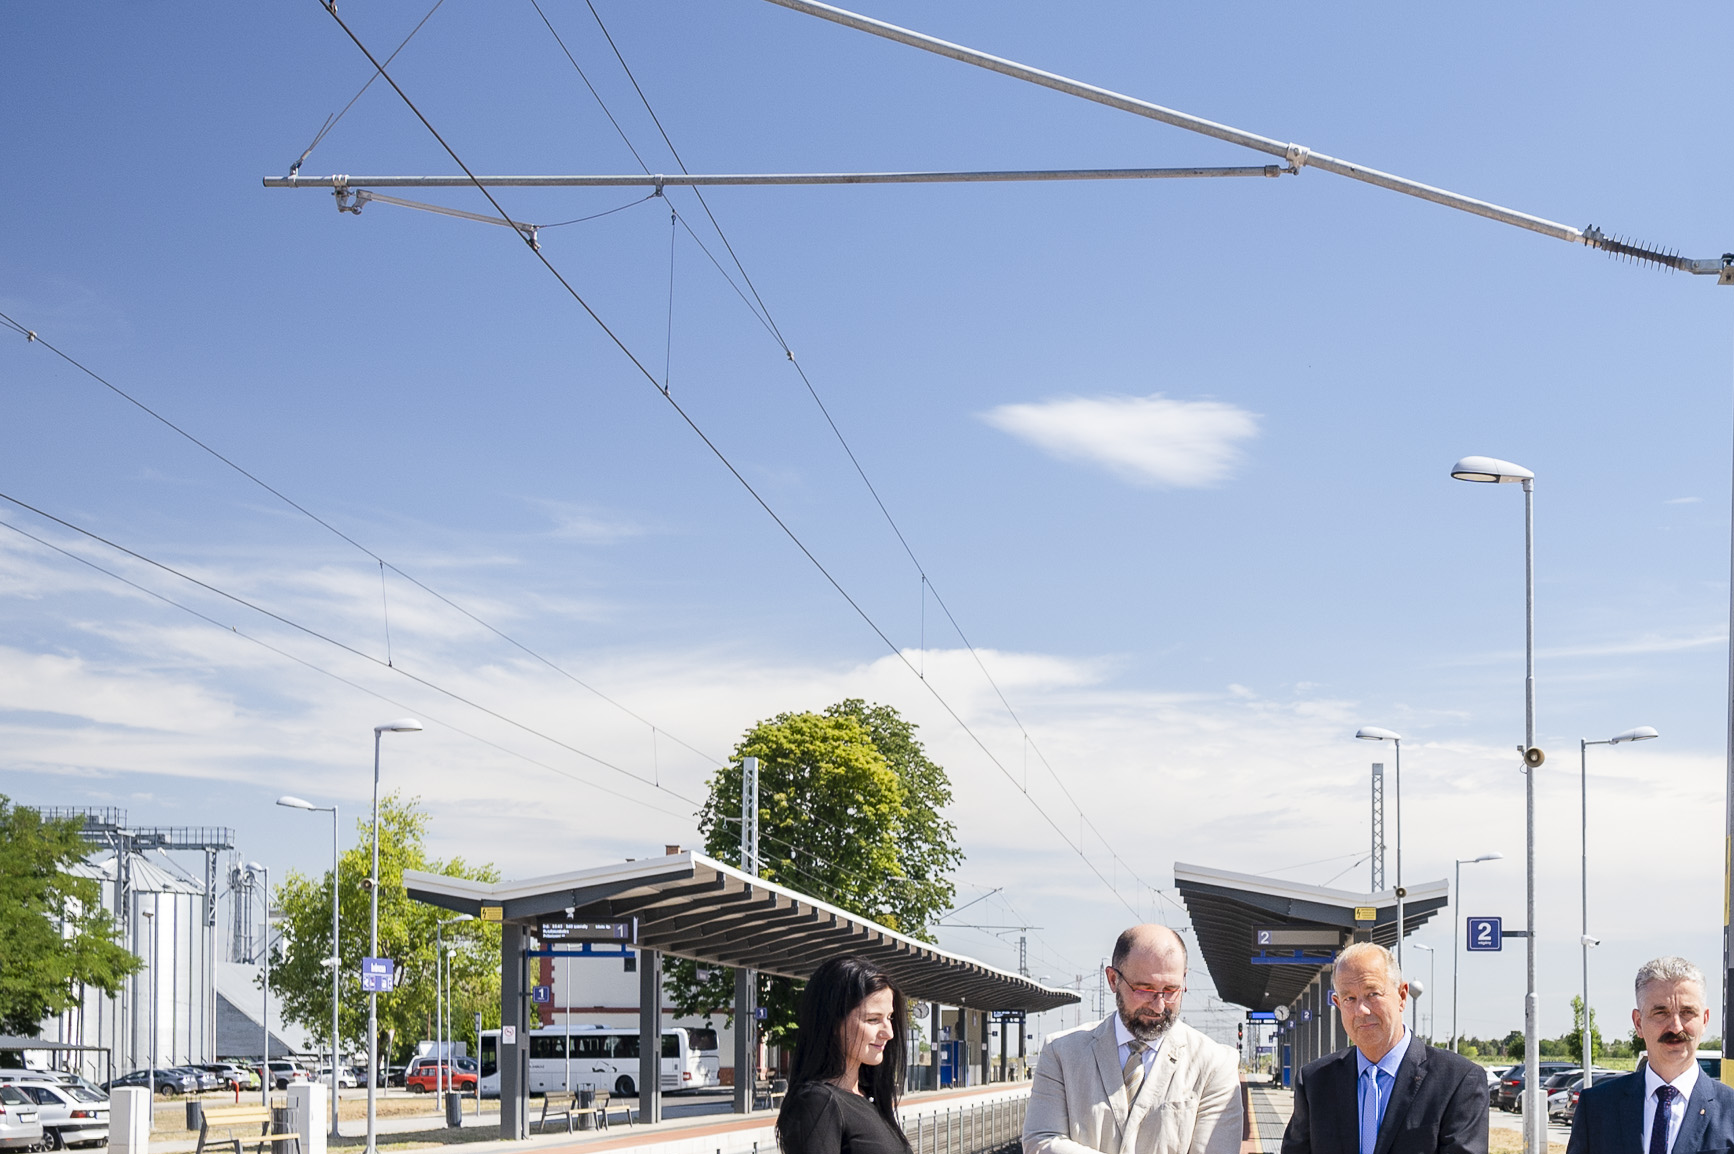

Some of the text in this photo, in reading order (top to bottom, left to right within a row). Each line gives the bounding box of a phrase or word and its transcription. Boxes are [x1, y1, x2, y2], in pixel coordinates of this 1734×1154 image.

[617, 925, 624, 938] 1
[1260, 931, 1270, 945] 2
[1478, 922, 1492, 941] 2
[538, 988, 544, 998] 1
